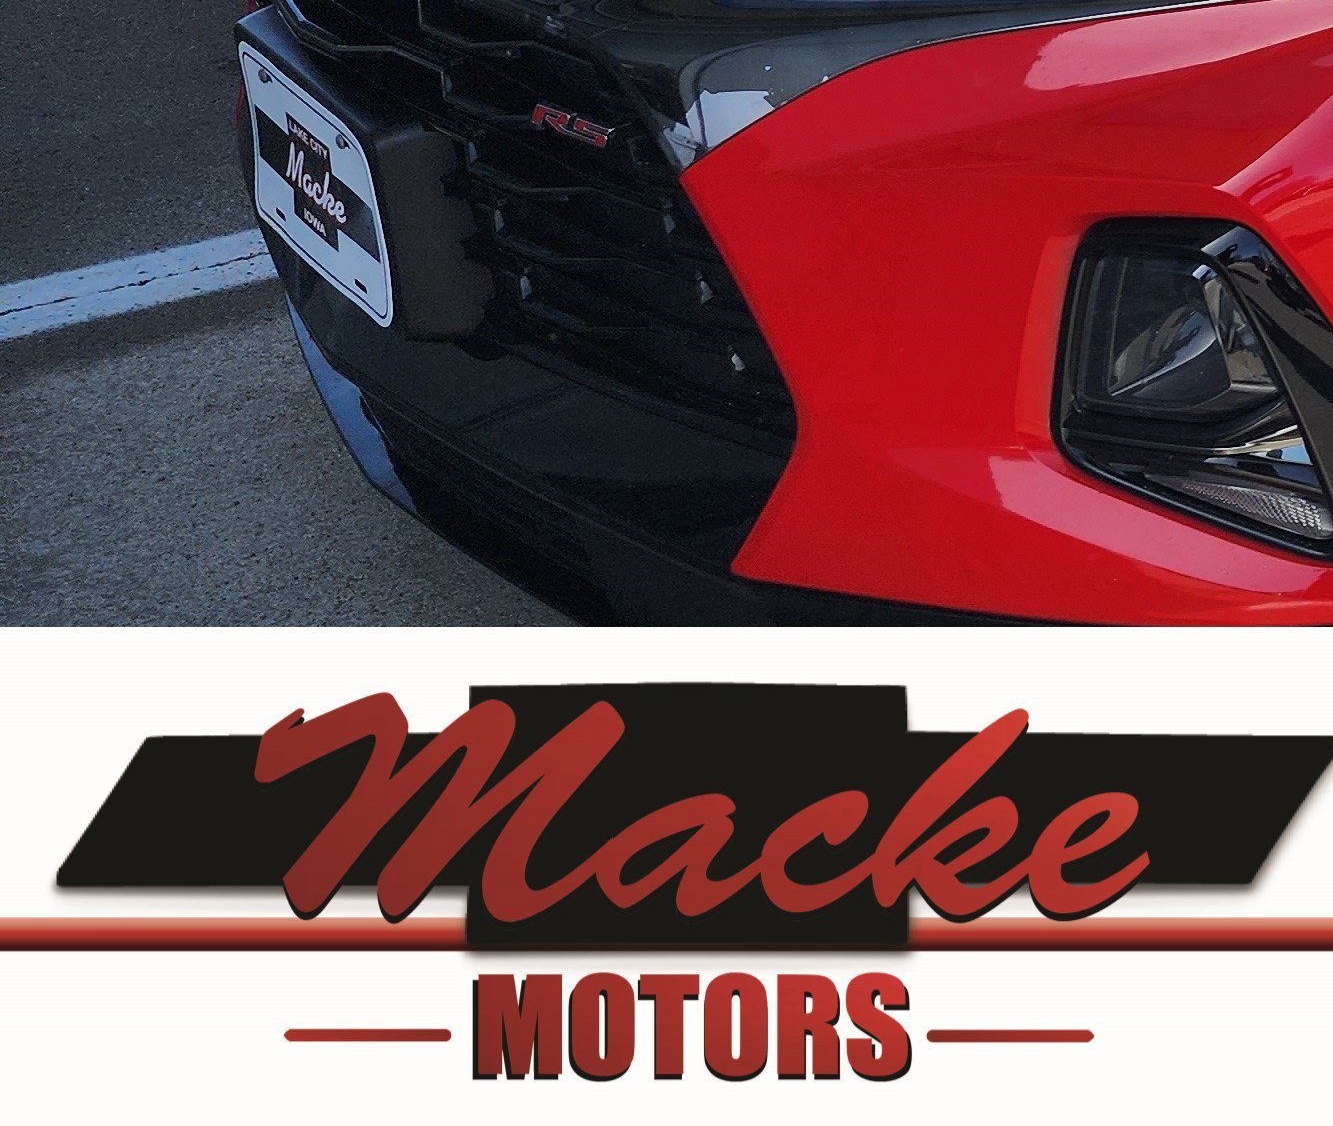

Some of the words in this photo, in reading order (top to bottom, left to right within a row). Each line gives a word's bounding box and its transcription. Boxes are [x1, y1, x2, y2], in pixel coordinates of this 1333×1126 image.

[289, 118, 310, 145] LAKE
[310, 137, 328, 160] CITY
[531, 104, 615, 147] RS
[286, 141, 347, 224] Macke
[303, 207, 327, 237] IOWA
